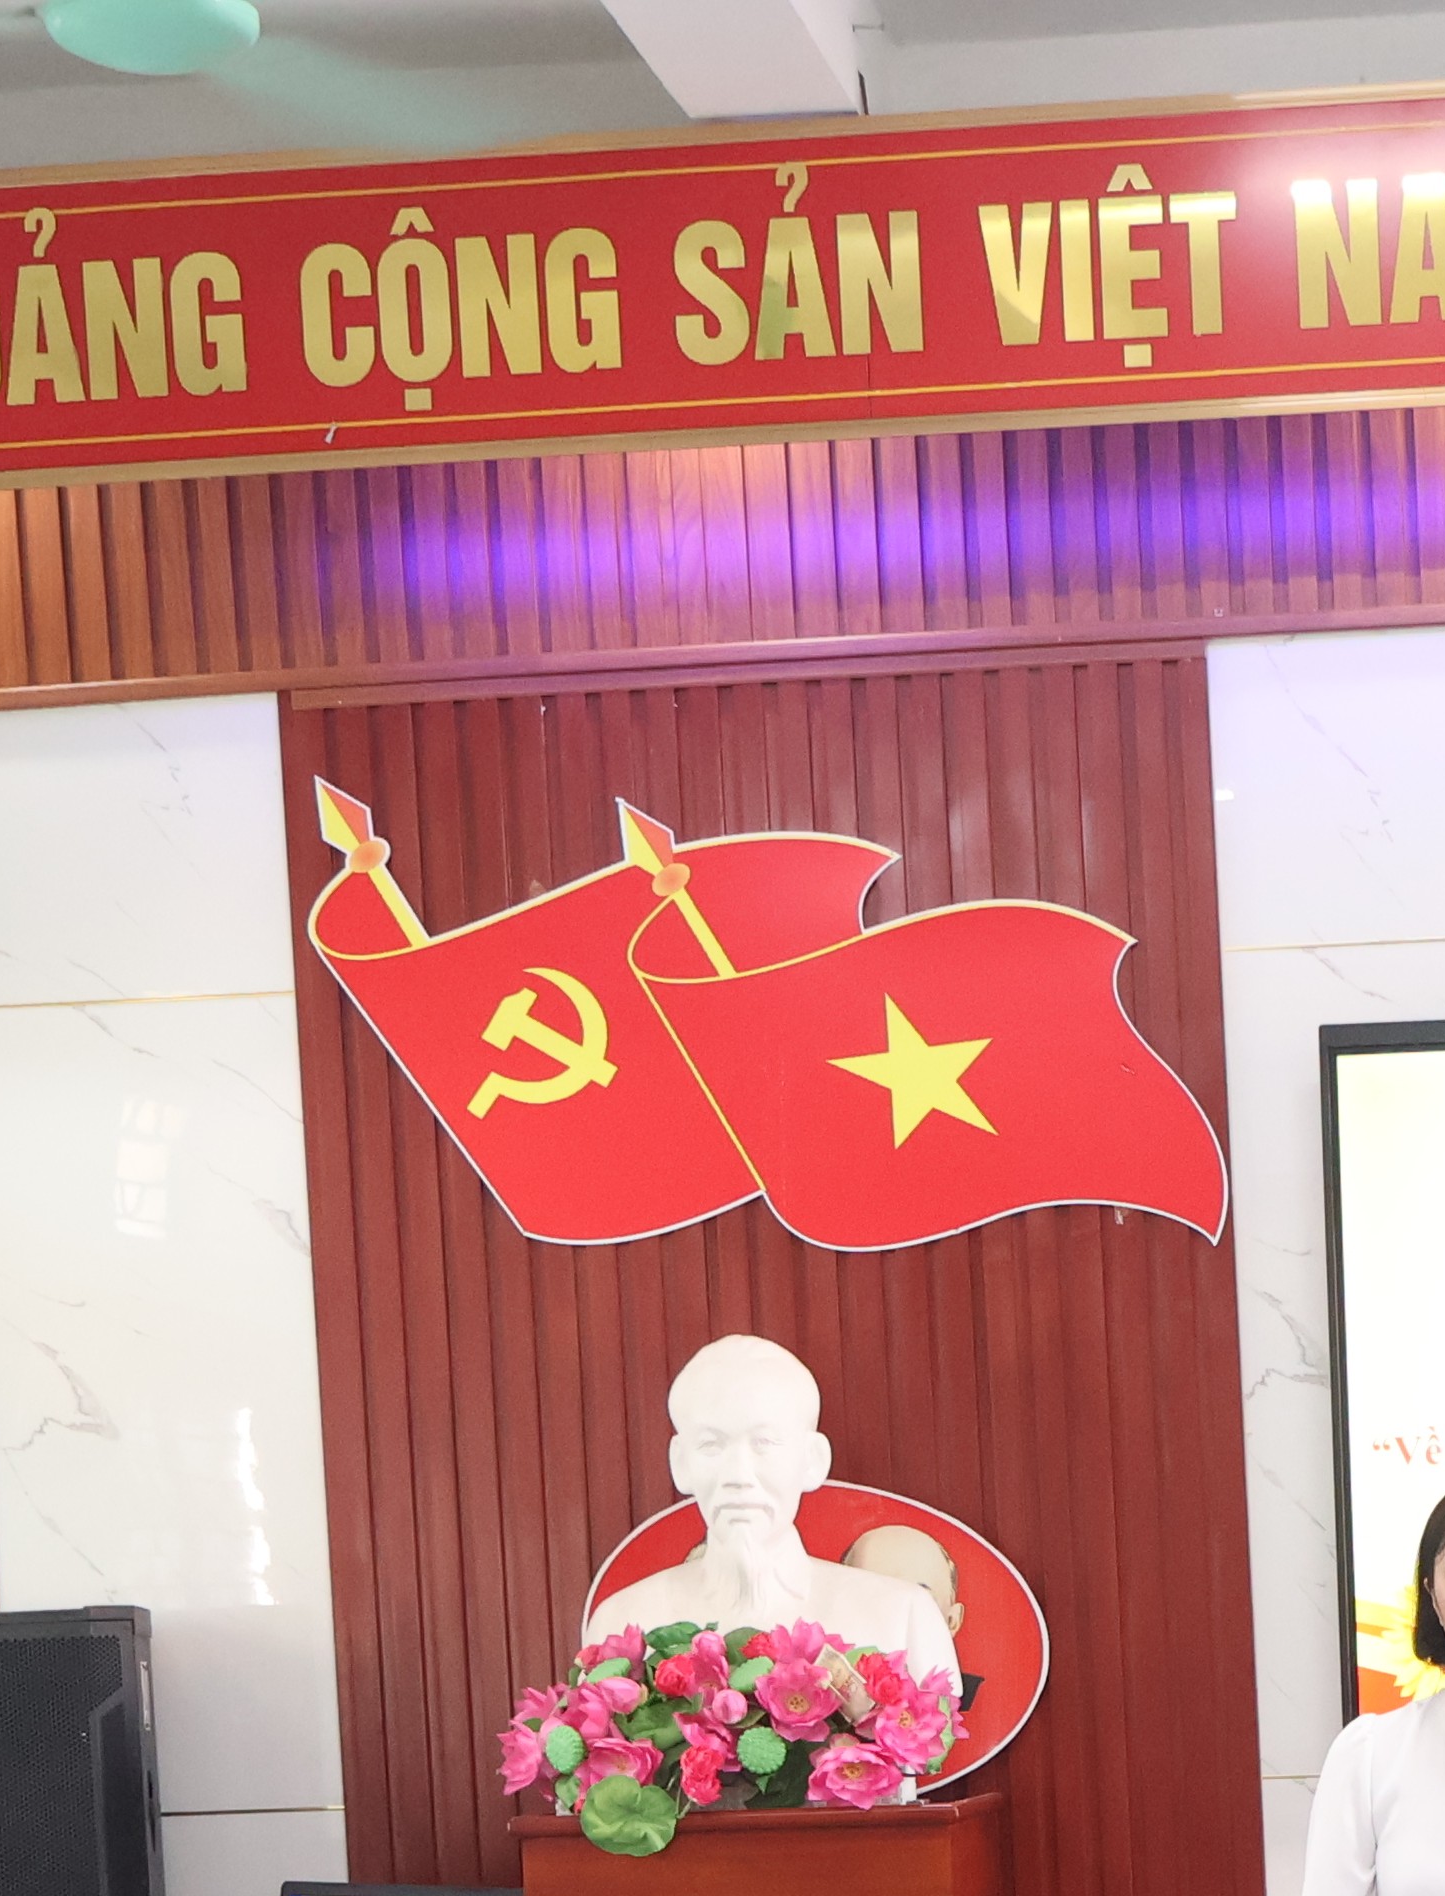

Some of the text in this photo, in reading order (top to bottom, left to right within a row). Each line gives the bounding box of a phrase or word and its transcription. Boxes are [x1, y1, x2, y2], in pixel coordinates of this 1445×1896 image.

[303, 208, 620, 410] CỘNG
[675, 161, 920, 364] SẢN
[979, 164, 1238, 368] VIỆT
[1372, 1426, 1442, 1465] “Về
